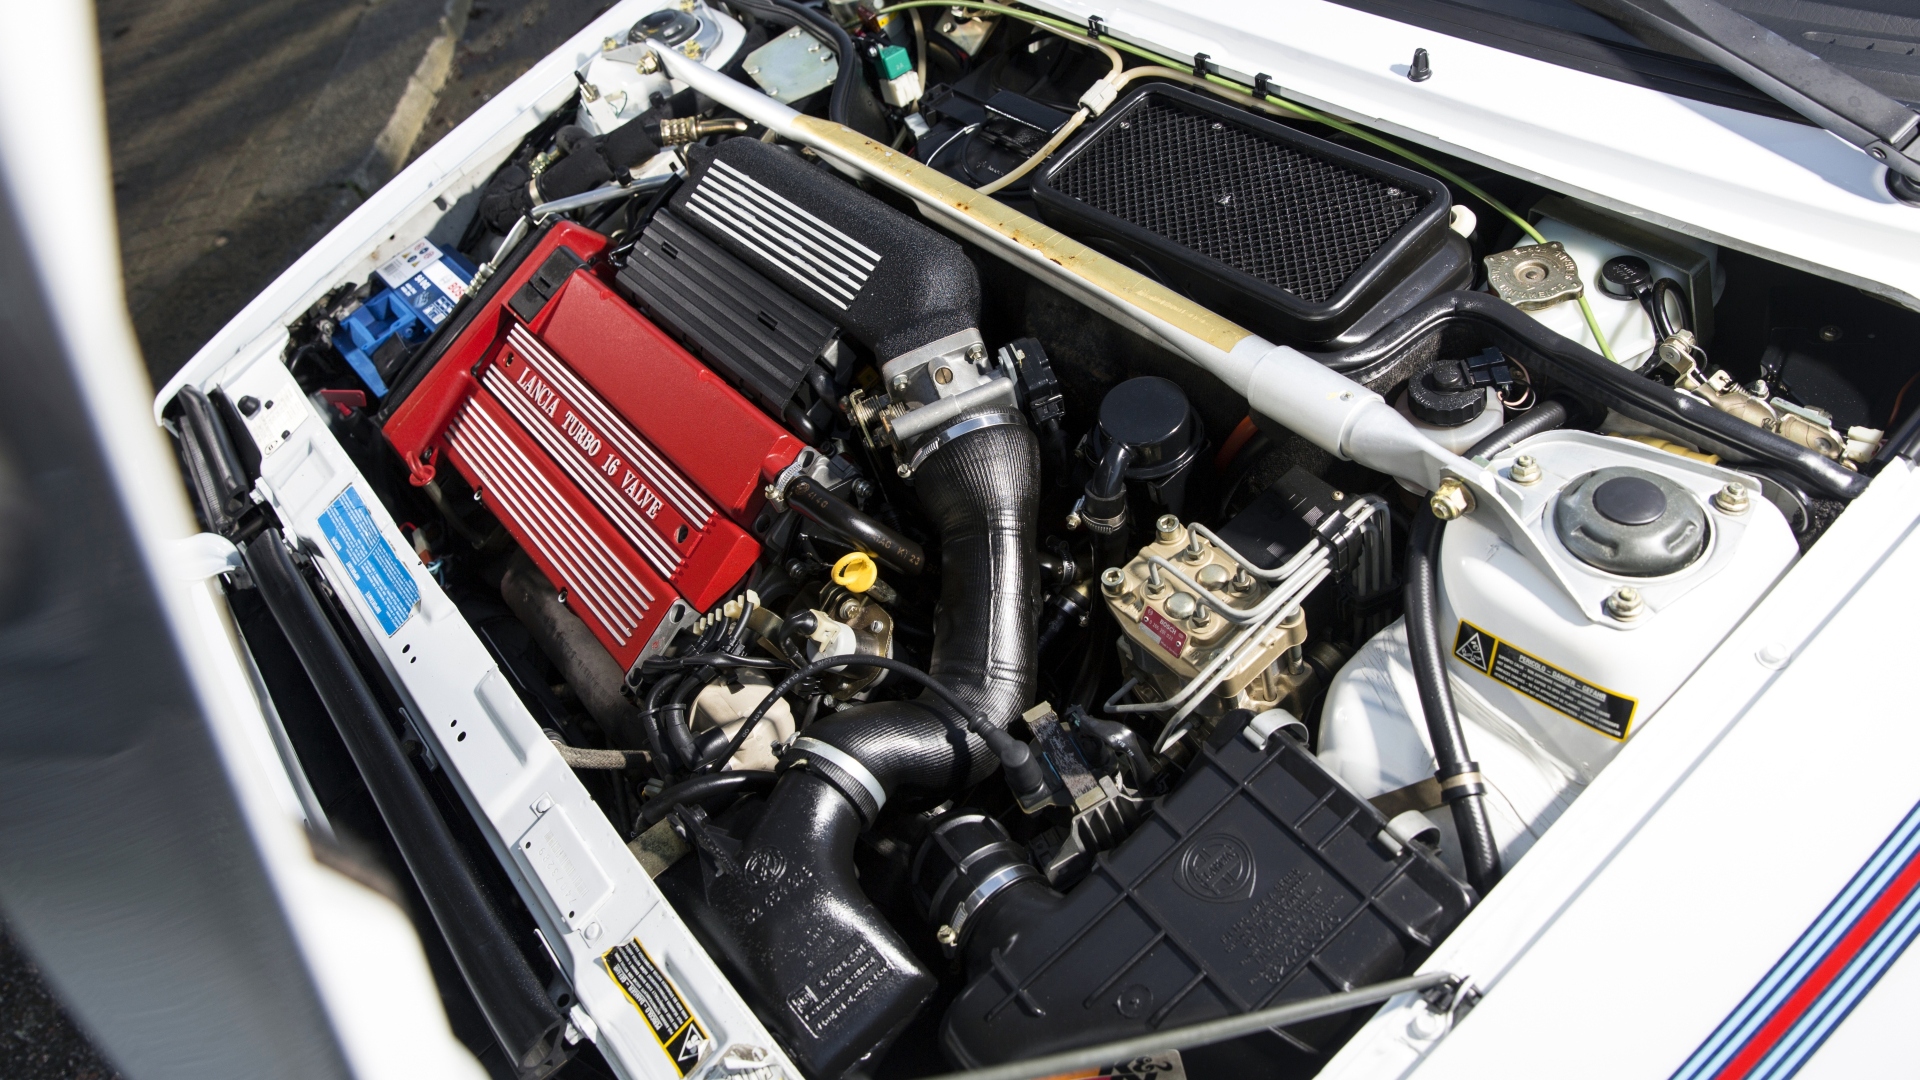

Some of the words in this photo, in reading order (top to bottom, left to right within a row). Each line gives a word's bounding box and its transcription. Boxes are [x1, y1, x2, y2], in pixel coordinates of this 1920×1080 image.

[446, 280, 466, 300] BOS
[516, 366, 560, 419] LANCIA
[565, 412, 601, 456] TURBO
[602, 454, 620, 476] 16
[620, 472, 664, 520] VALVE
[1158, 618, 1177, 634] BOSCH
[1519, 654, 1546, 673] PERICOLO
[1552, 670, 1576, 687] DANGER
[1582, 684, 1607, 701] GEFAHR
[1203, 850, 1236, 881] LANCIA
[628, 984, 645, 1006] DANGER
[645, 1006, 663, 1031] PERICOLO
